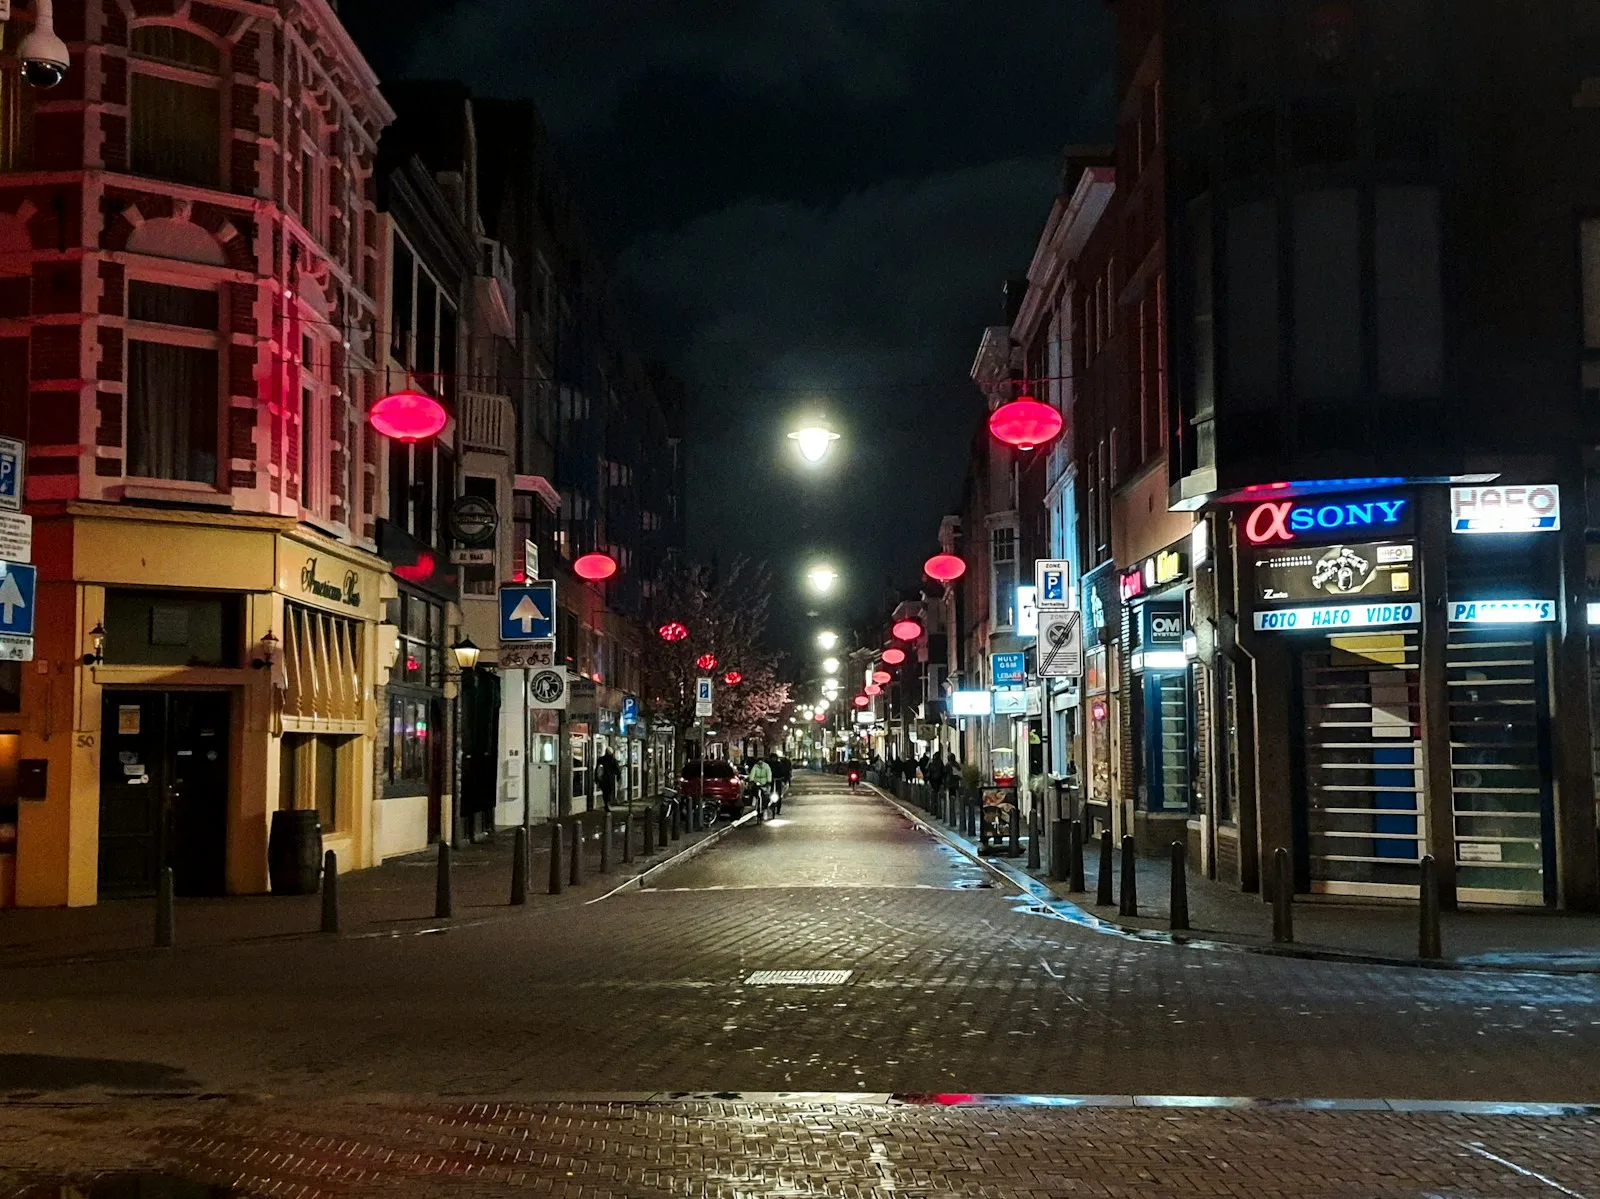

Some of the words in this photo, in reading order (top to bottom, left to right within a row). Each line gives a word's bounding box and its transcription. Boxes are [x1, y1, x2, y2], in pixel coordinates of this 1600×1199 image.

[1455, 488, 1556, 517] HAFO
[1290, 500, 1405, 530] SONY
[1152, 618, 1180, 632] OM
[1261, 610, 1297, 629] FOTO
[1311, 609, 1351, 625] HAFO
[1366, 605, 1413, 623] VIDEO
[76, 735, 95, 748] 50
